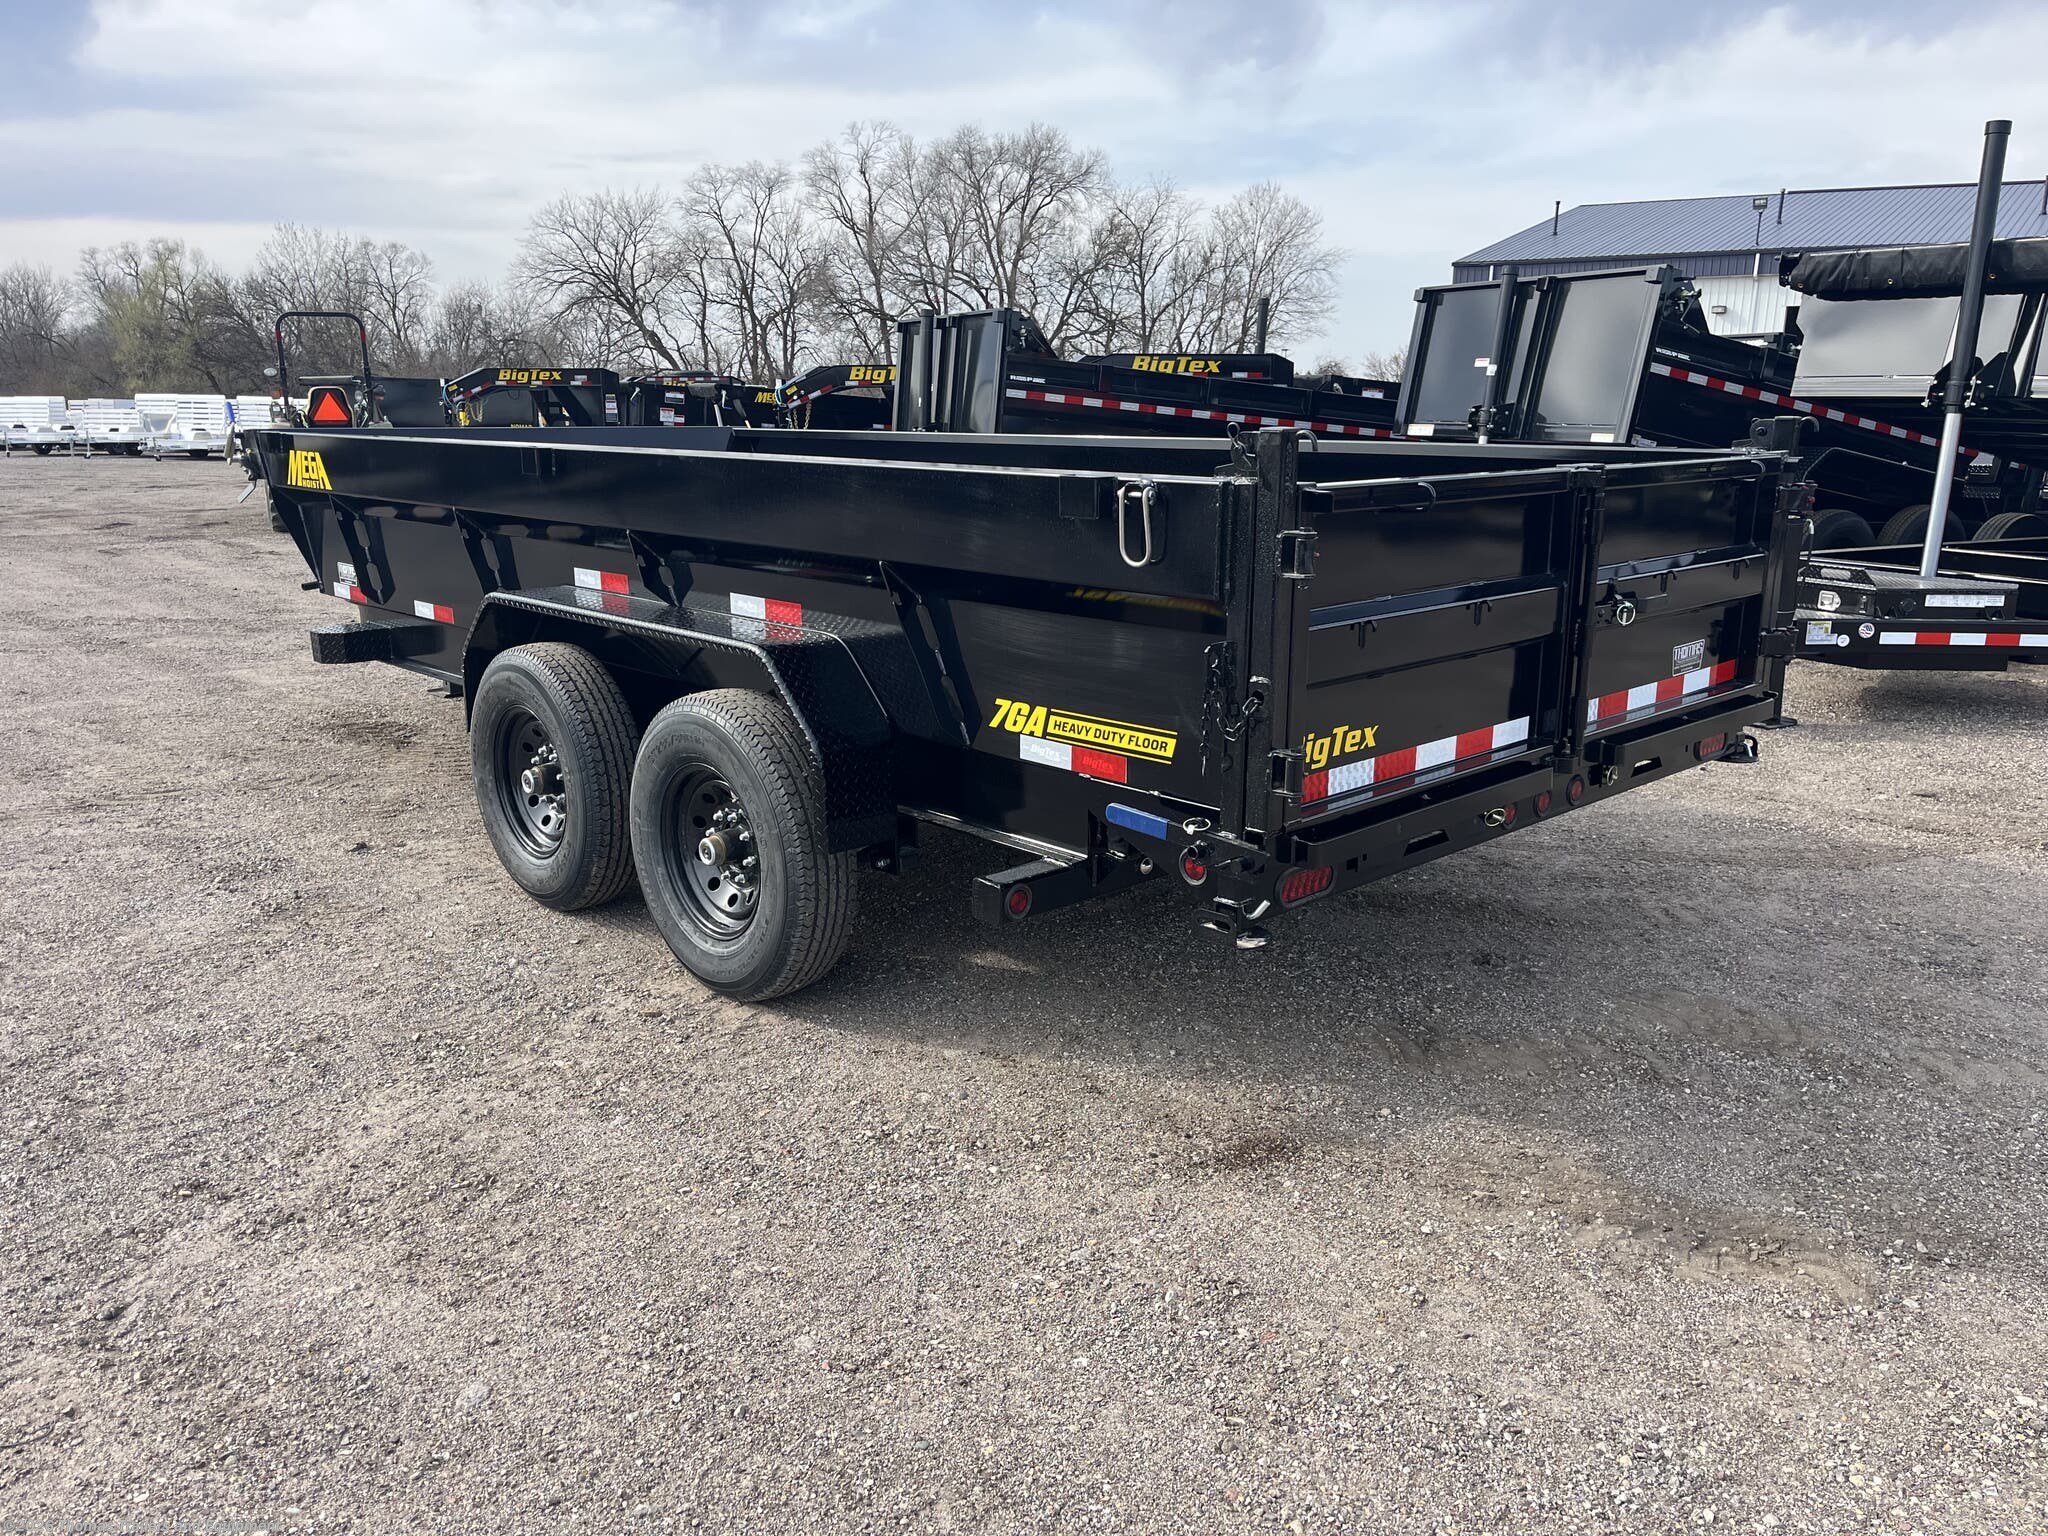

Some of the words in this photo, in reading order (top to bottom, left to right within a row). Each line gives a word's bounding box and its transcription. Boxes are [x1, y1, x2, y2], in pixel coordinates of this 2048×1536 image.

[1132, 356, 1222, 374] BigTex
[498, 368, 562, 383] BigTex
[849, 366, 896, 384] BigT
[287, 450, 333, 490] MEGA
[302, 479, 320, 489] HOIST
[988, 698, 1047, 737] 7GA
[1053, 719, 1093, 739] HEAVY
[1093, 728, 1127, 745] DUTY
[1127, 734, 1168, 753] FLOOR
[1302, 725, 1379, 770] igTex
